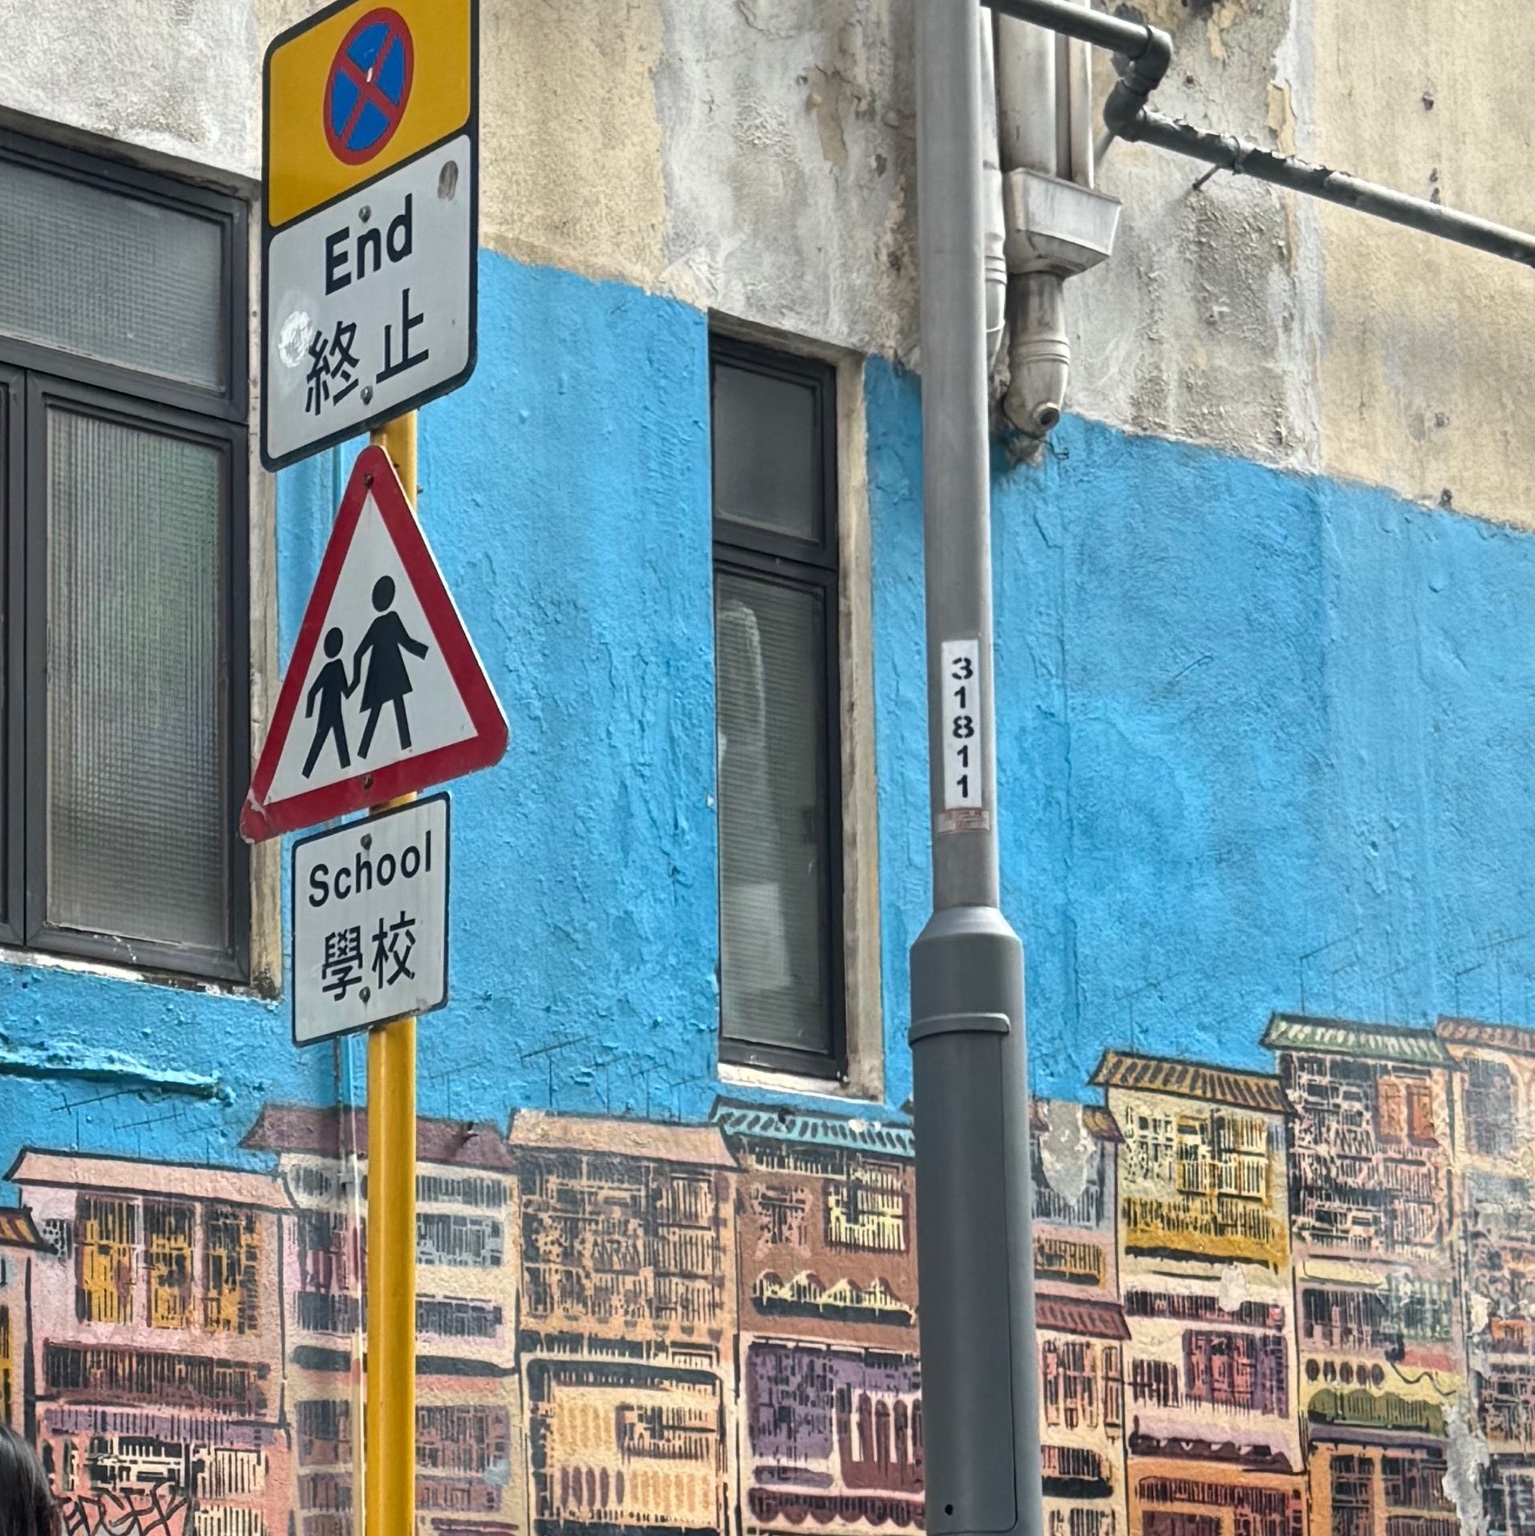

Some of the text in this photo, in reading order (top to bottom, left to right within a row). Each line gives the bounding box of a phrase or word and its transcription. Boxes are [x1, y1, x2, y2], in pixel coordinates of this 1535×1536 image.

[324, 193, 413, 296] End
[305, 288, 430, 416] 終止
[951, 657, 975, 798] 31811
[308, 829, 432, 908] School
[321, 910, 417, 1002] 學校
